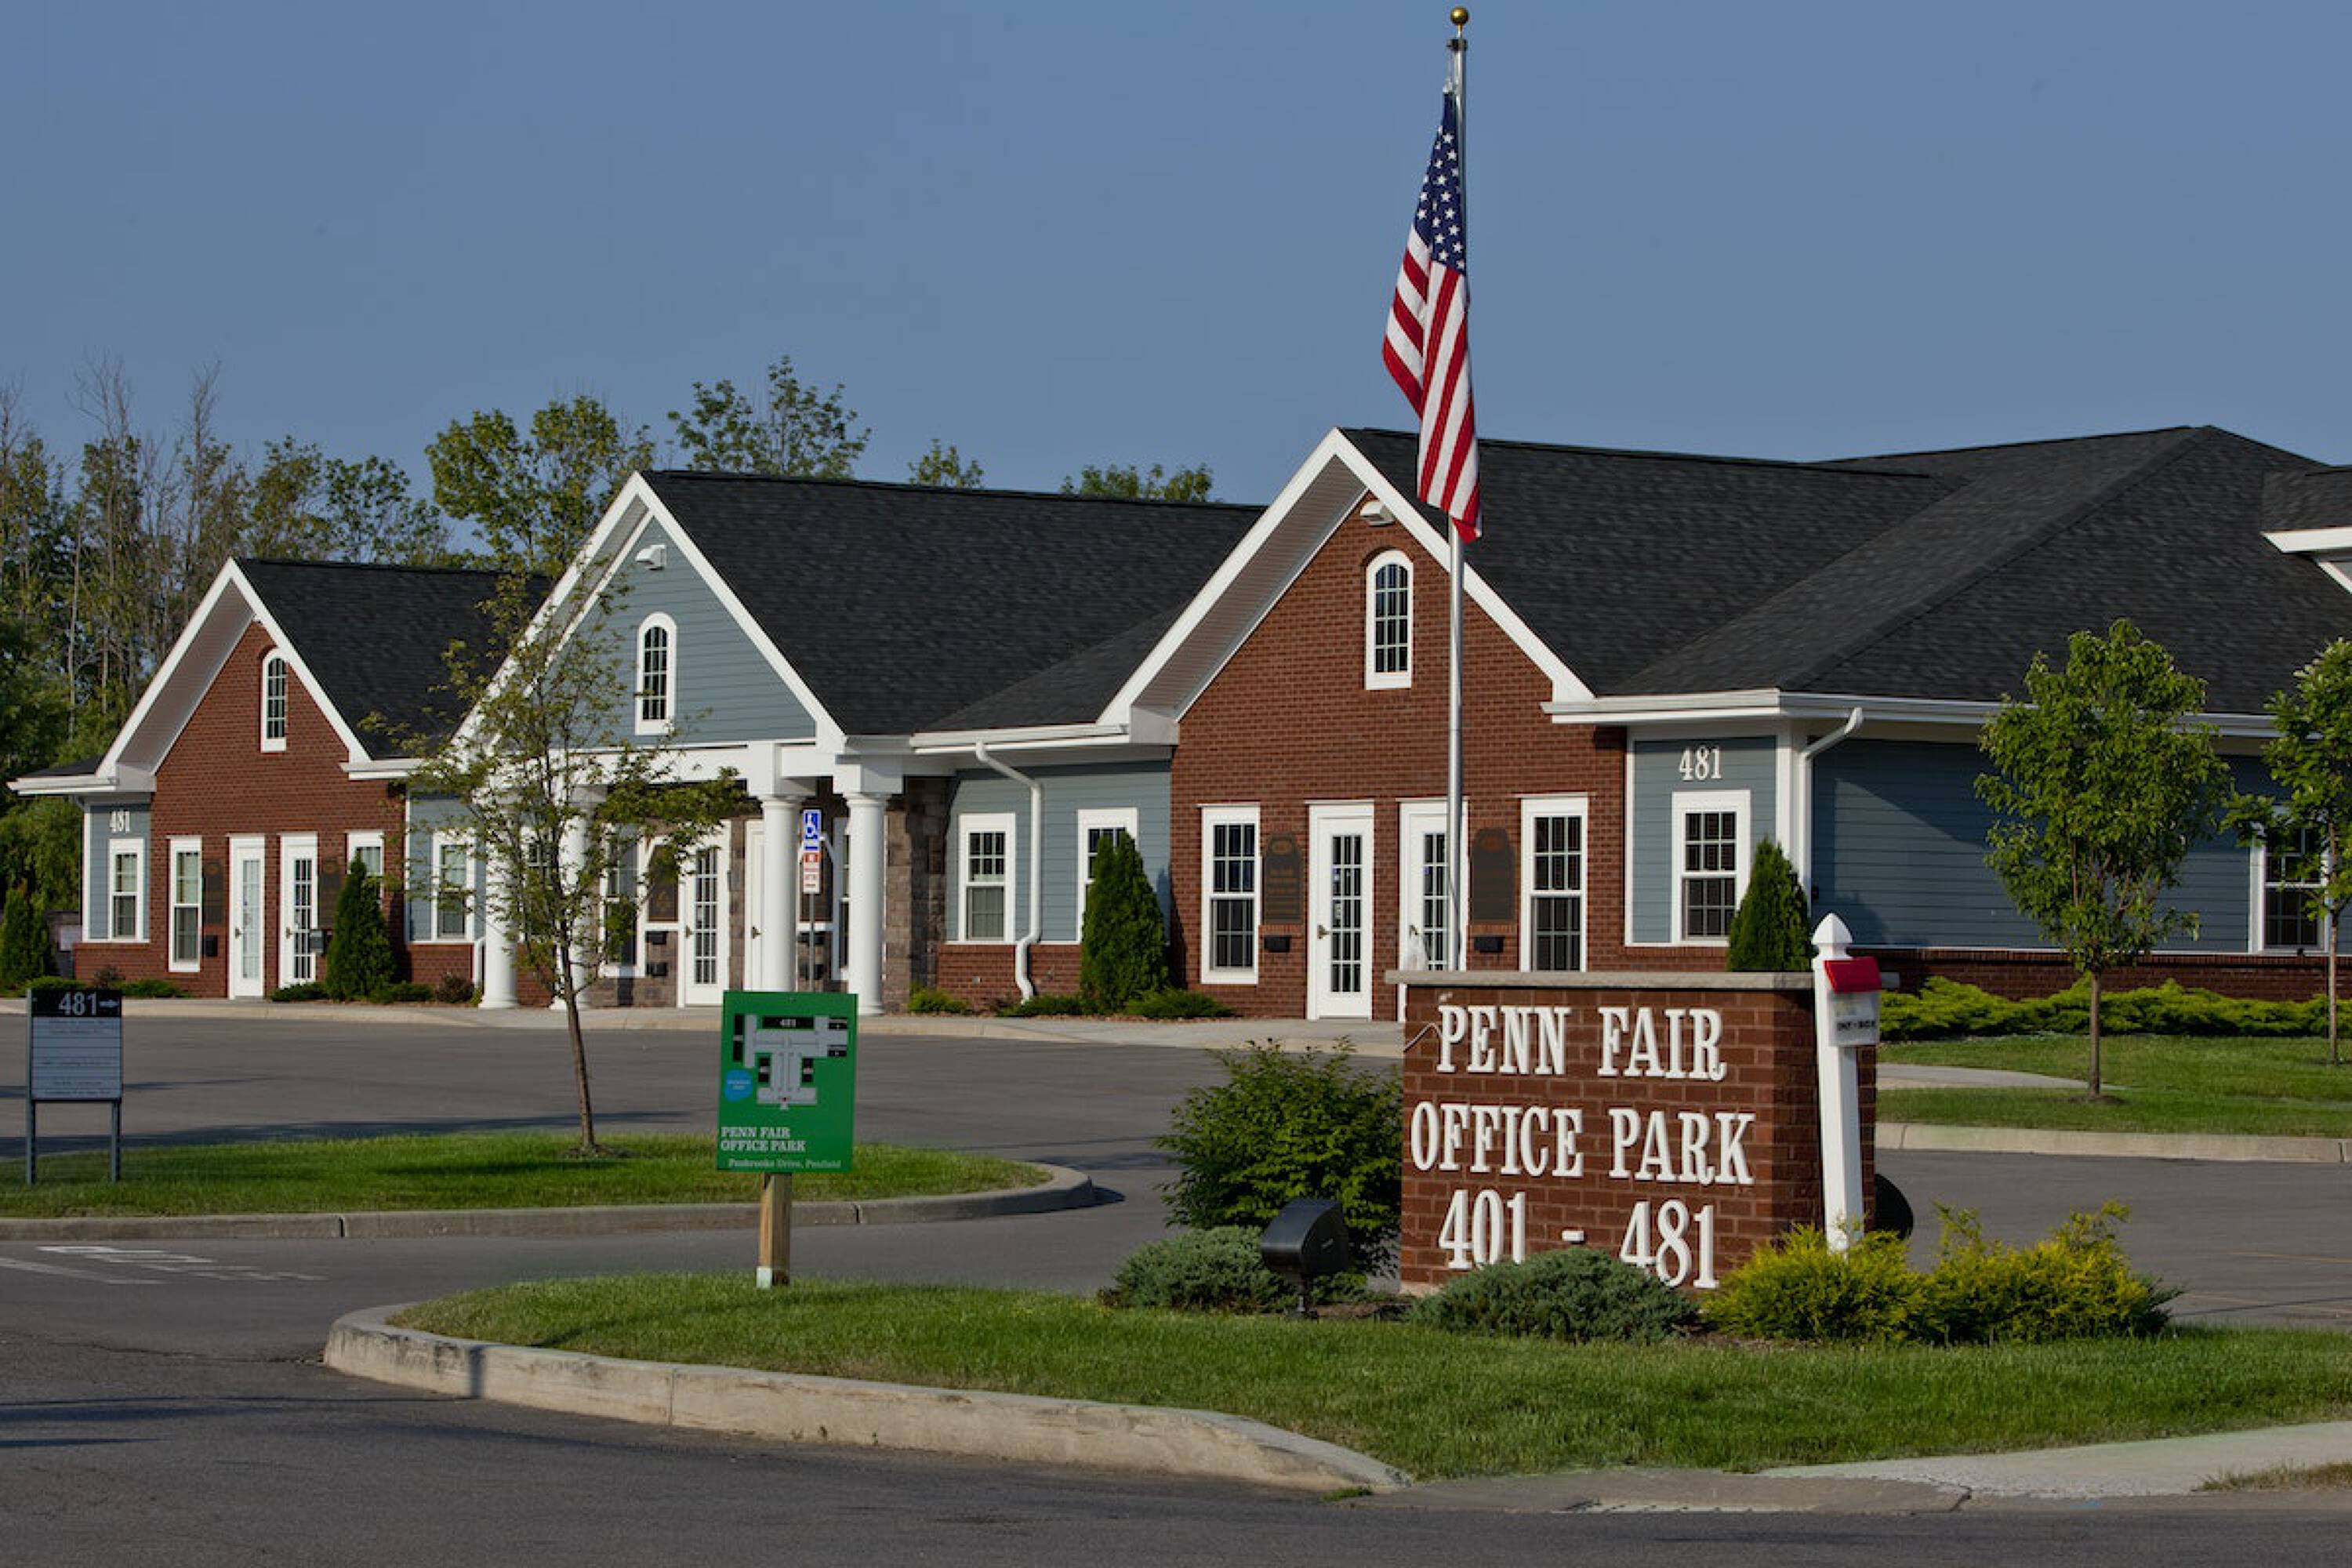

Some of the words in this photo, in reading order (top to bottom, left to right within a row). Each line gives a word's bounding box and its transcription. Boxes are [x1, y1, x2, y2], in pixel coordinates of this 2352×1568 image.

[1679, 746, 1722, 780] 481
[110, 811, 130, 833] 481
[59, 991, 97, 1015] 481
[1436, 1005, 1571, 1075] PENN
[1597, 1007, 1726, 1081] FAIR
[720, 1126, 757, 1138] PENN
[760, 1127, 791, 1138] FAIR
[720, 1139, 768, 1151] OFFICE
[770, 1140, 807, 1152] PARK
[1410, 1101, 1584, 1176] OFFICE
[1608, 1109, 1756, 1185] PARK
[1438, 1189, 1526, 1271] 401
[1619, 1199, 1720, 1290] 481
